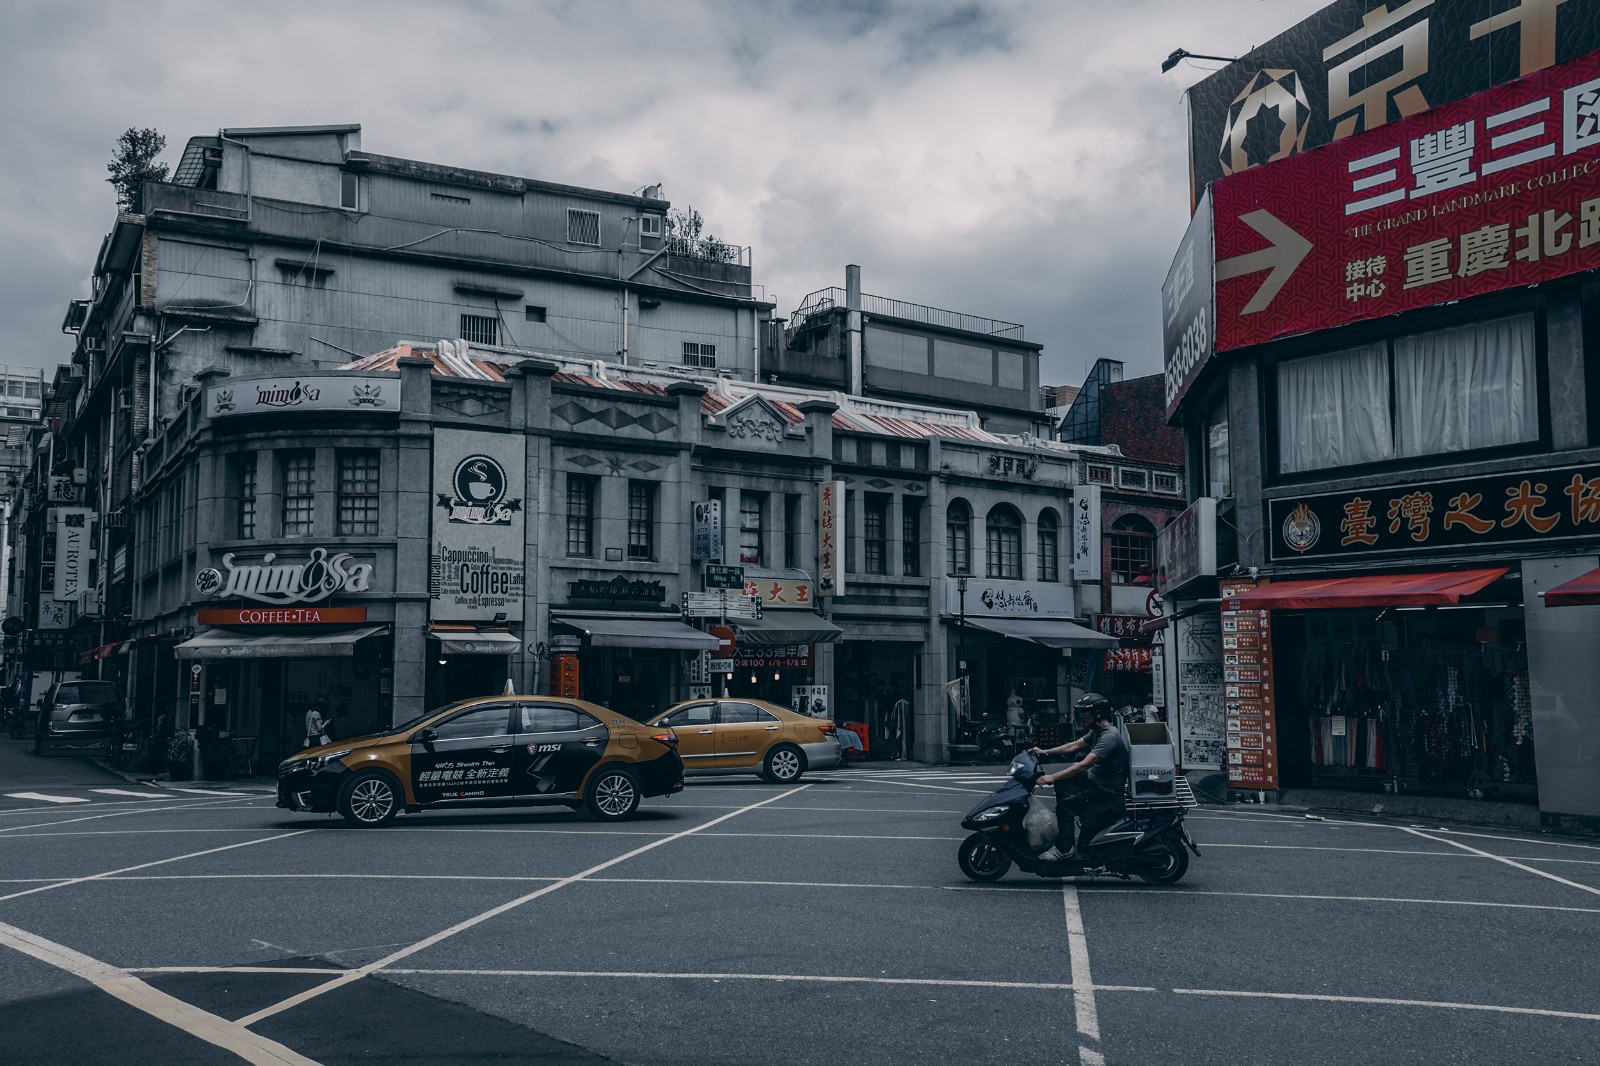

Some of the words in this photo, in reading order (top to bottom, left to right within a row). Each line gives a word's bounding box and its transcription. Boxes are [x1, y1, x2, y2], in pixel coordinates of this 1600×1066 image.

[1345, 223, 1373, 239] THE
[1377, 208, 1427, 233] GRAND
[1432, 183, 1522, 216] LANDMARK
[1346, 255, 1387, 282] 接待
[1346, 278, 1387, 303] 中心
[65, 529, 80, 597] AUROTEX
[442, 546, 489, 565] Cappuccino
[460, 562, 509, 595] Coffee
[478, 594, 505, 608] Espresso
[538, 743, 561, 752] msi
[465, 767, 511, 780] 全新定義
